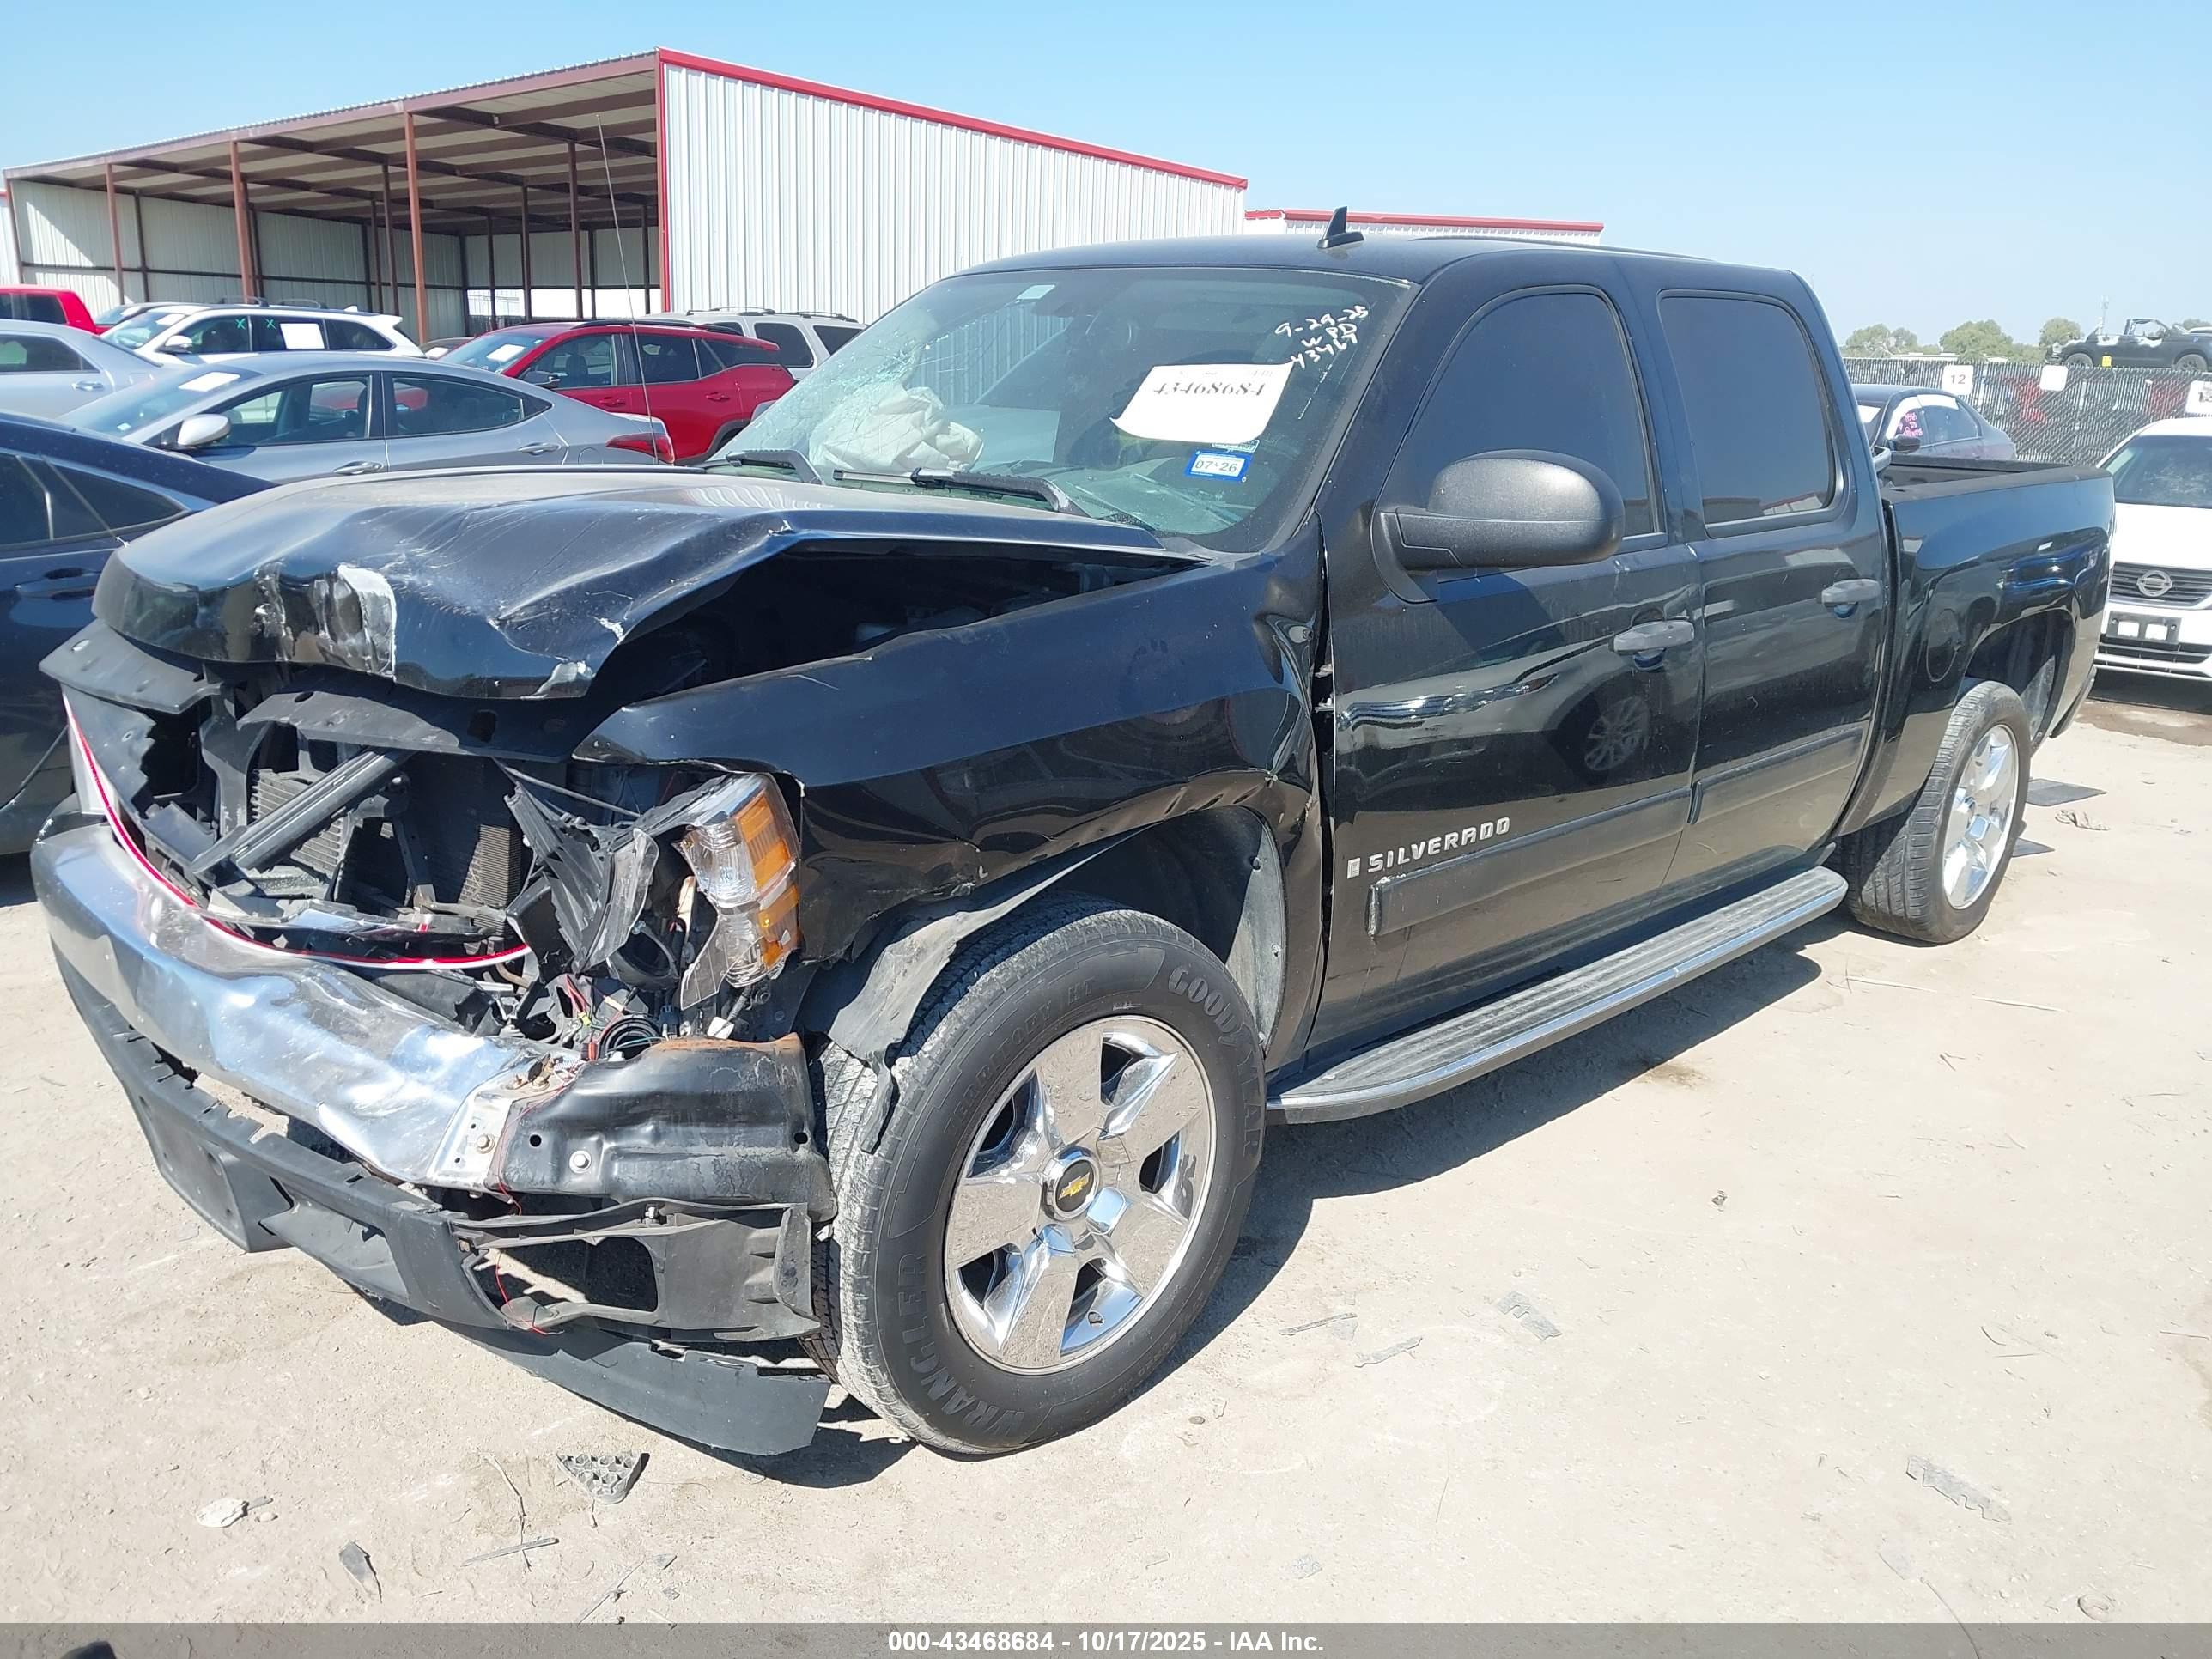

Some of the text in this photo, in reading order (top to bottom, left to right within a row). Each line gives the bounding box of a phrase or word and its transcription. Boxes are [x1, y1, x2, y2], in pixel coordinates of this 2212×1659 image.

[1950, 374, 1966, 385] 12
[1367, 816, 1511, 873] SILVERADO
[898, 1252, 1025, 1437] WRANGLER
